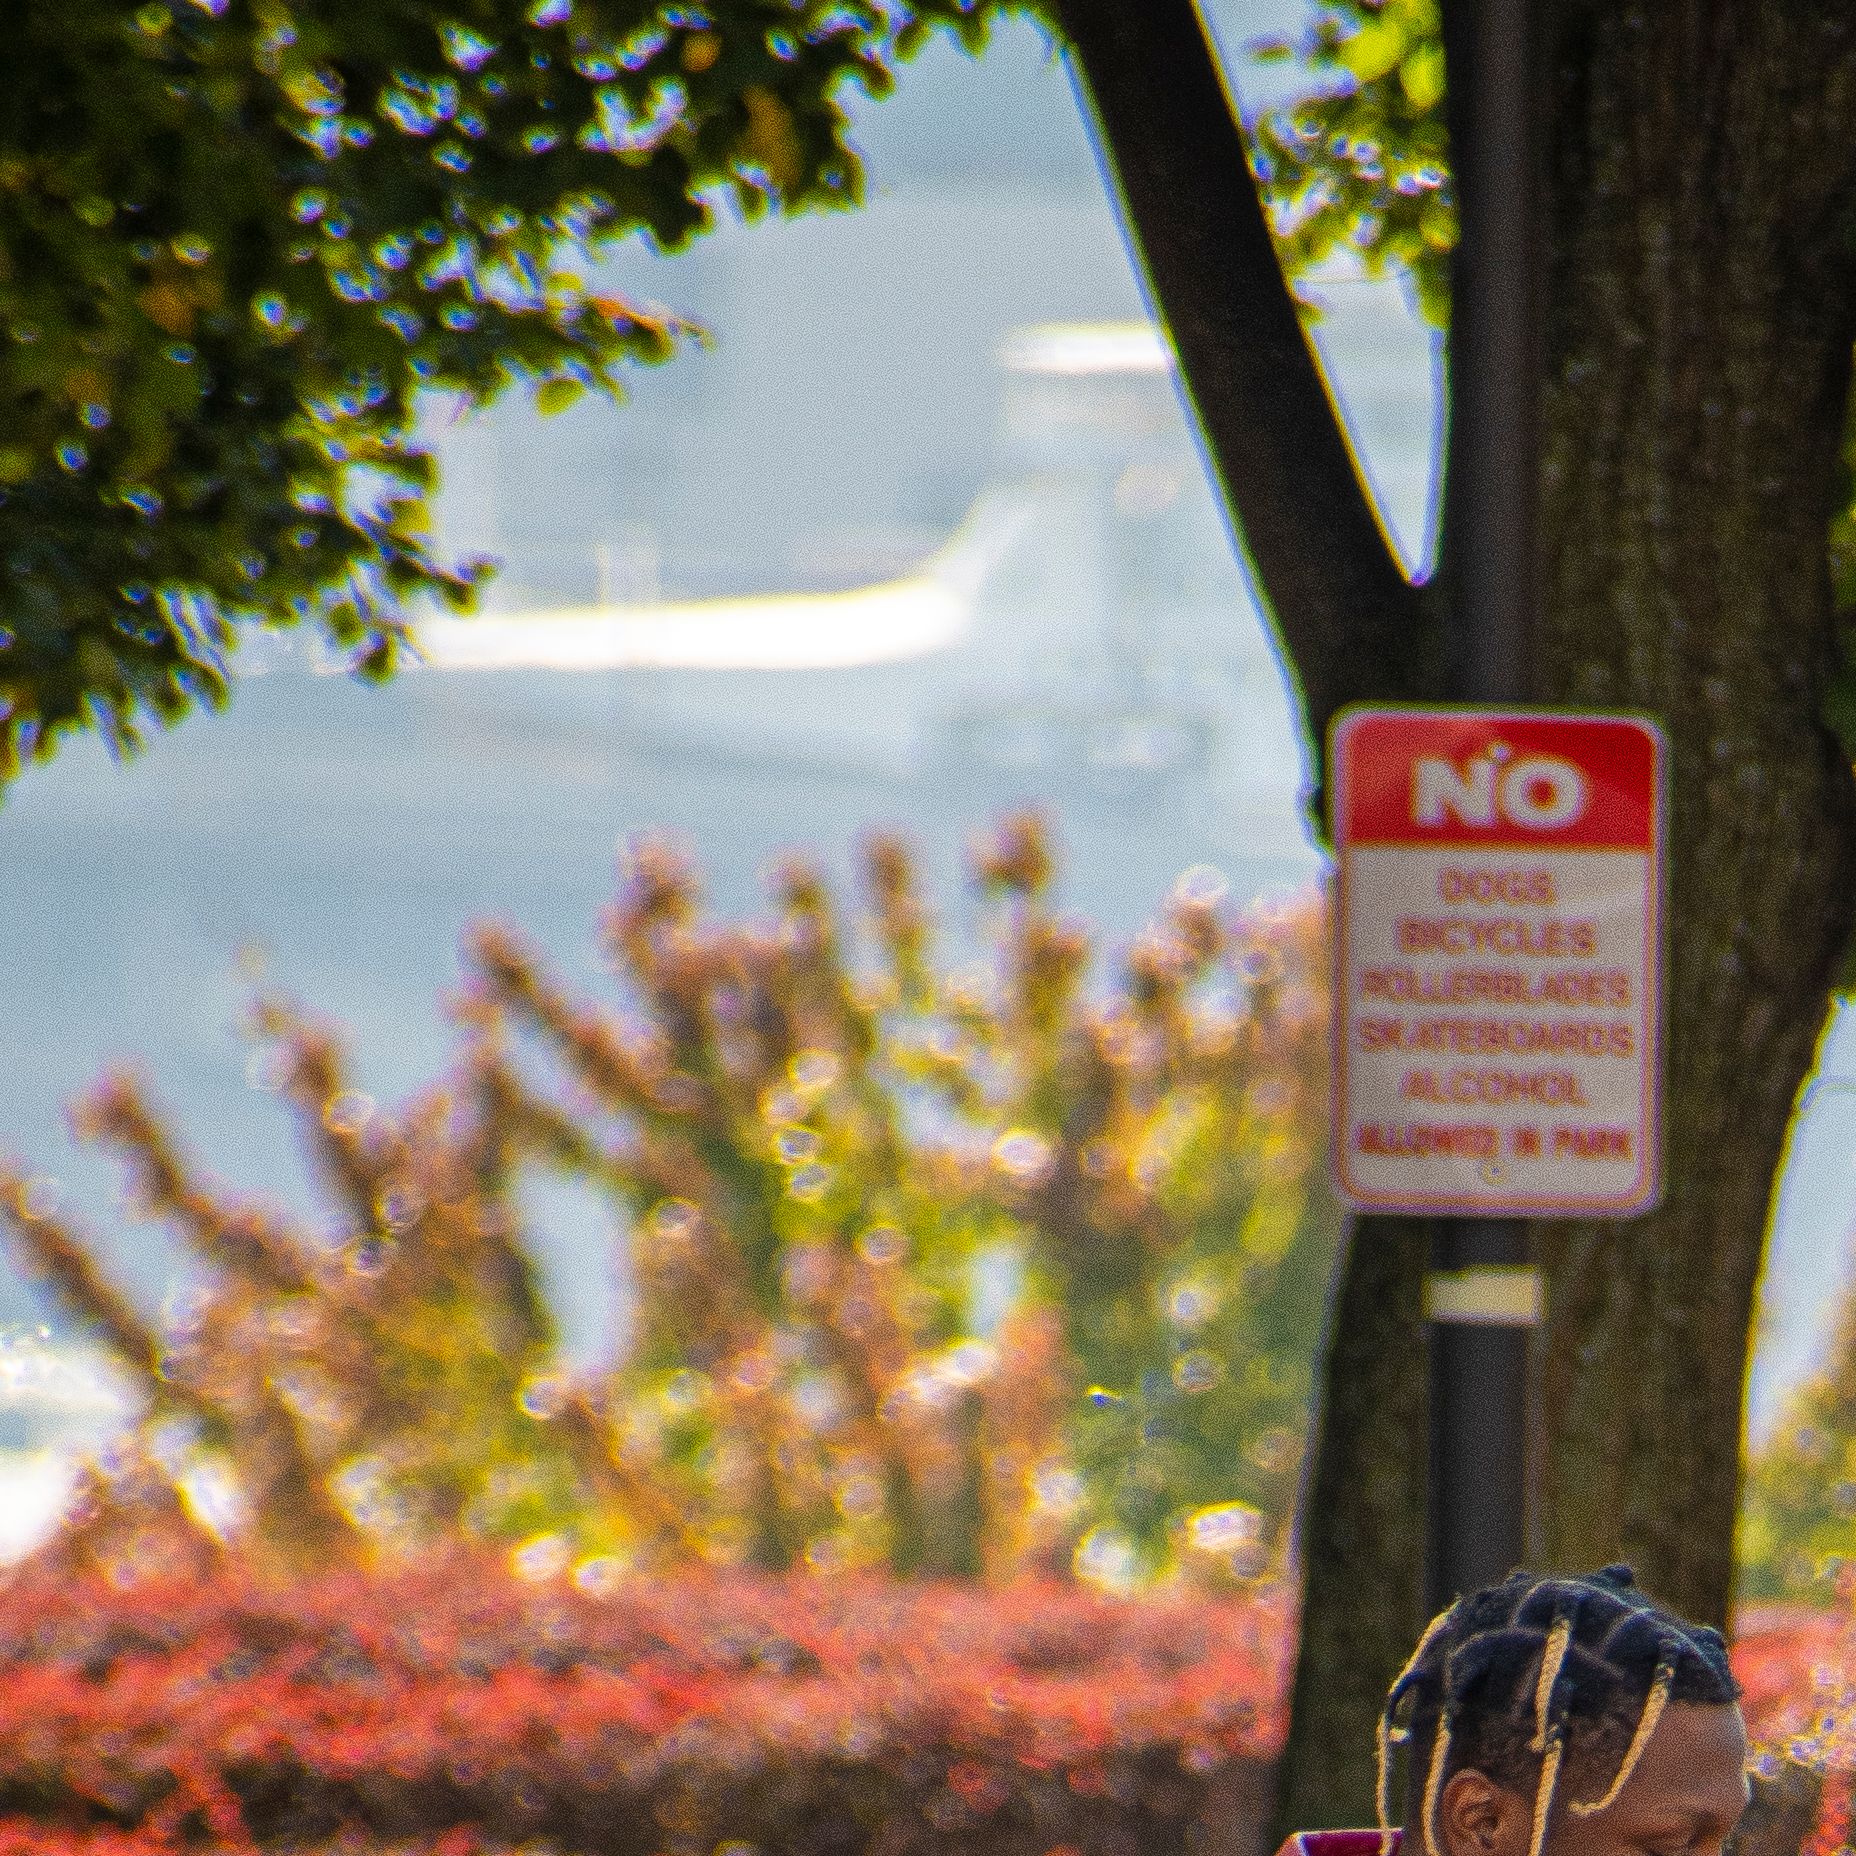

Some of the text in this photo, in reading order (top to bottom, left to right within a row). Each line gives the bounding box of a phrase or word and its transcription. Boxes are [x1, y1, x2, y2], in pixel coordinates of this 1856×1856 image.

[1412, 752, 1586, 830] NO
[1439, 867, 1556, 907] DOGS
[1393, 918, 1597, 957] BICYCLES
[1358, 966, 1632, 1008] ROLLERBLADES
[1358, 1017, 1635, 1058] SKATEBOARDS
[1400, 1068, 1587, 1106] ALCOHOL
[1357, 1122, 1634, 1161] ALLOWED IN PARK
